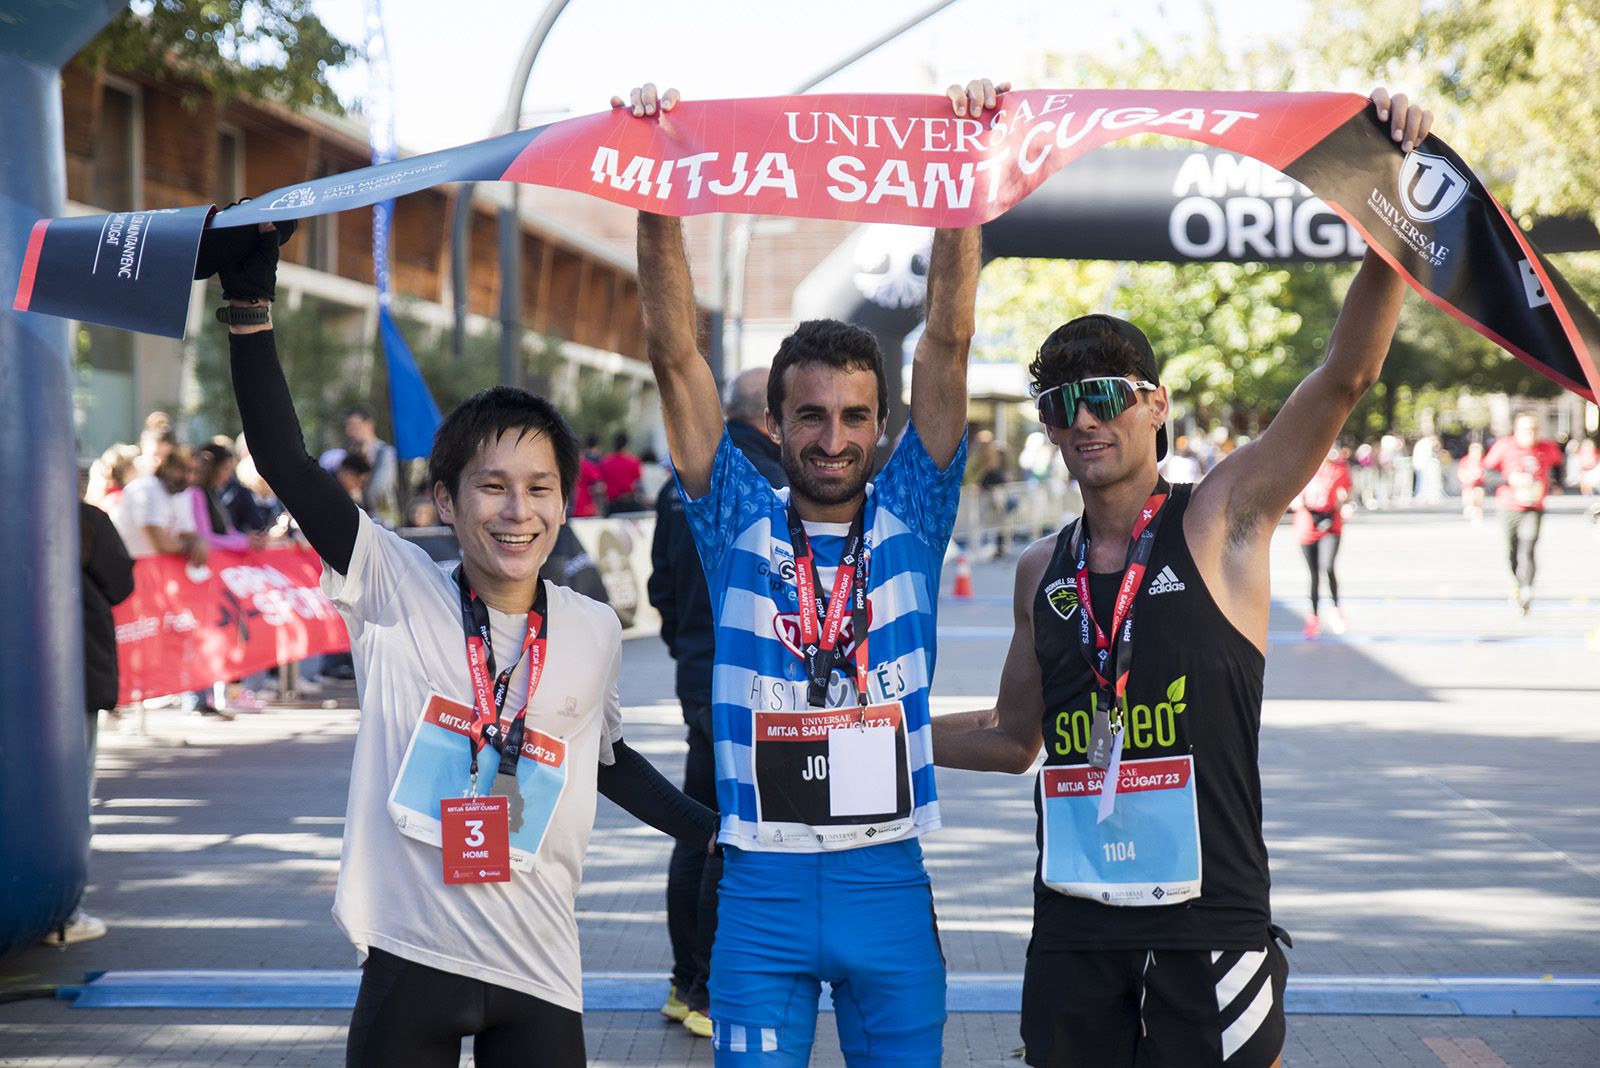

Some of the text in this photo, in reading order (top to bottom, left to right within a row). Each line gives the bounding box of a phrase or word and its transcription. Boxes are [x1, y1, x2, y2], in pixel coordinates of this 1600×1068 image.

[784, 94, 1073, 153] UNIVERSAE
[590, 107, 1260, 210] MITJA SANT CUGAT
[1172, 153, 1315, 198] AME
[1371, 187, 1450, 261] UNIVERSAE
[1391, 224, 1419, 252] Superior
[1429, 257, 1443, 267] FP
[838, 573, 851, 598] CUGAT
[1117, 570, 1137, 616] MITJA SANT
[1148, 582, 1185, 595] adidas
[797, 563, 813, 635] MITJA SANT CUGAT
[815, 598, 826, 618] RPM
[833, 599, 845, 620] SANT
[857, 588, 865, 609] RPM
[828, 619, 839, 644] MITJA
[1080, 608, 1090, 645] SPORTS
[1123, 620, 1133, 642] RPM
[533, 645, 541, 664] MITJA
[468, 643, 491, 716] MITJA SANT CUGAT
[495, 684, 506, 706] RPM
[767, 725, 799, 737] MITJA
[801, 713, 851, 726] UNIVERSAE
[438, 712, 471, 732] MITJA
[544, 751, 556, 762] 23
[802, 755, 832, 781] JO
[1057, 781, 1085, 793] MITJA
[1121, 774, 1163, 788] CUGAT
[1165, 774, 1180, 785] 23
[464, 819, 485, 848] 3
[462, 850, 489, 860] HOME
[1103, 841, 1136, 863] 1104
